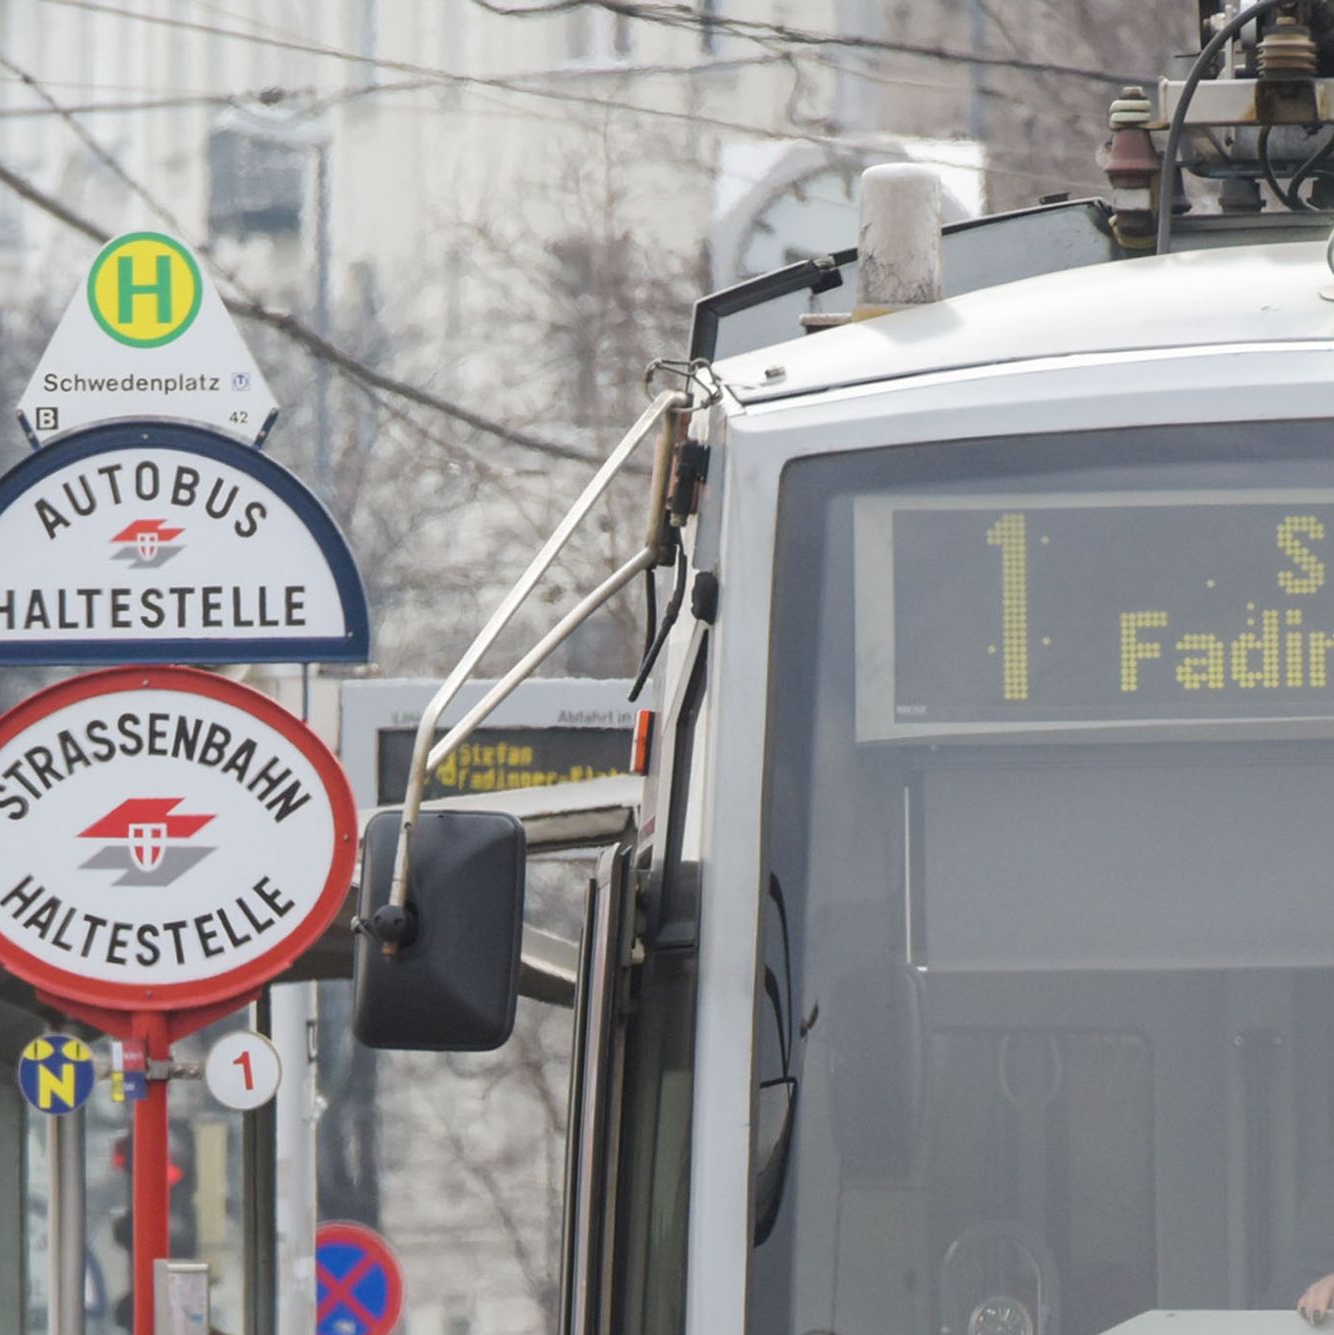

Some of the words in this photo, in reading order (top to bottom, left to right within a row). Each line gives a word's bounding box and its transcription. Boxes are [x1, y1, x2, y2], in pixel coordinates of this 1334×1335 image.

[117, 255, 172, 324] H
[43, 373, 220, 395] Schwedenplatz
[38, 409, 57, 428] B
[229, 411, 249, 424] 42
[34, 460, 267, 540] AUTOBUS
[986, 514, 1029, 700] 1
[460, 741, 533, 767] Stefan
[37, 1063, 76, 1109] N
[232, 1050, 254, 1091] 1
